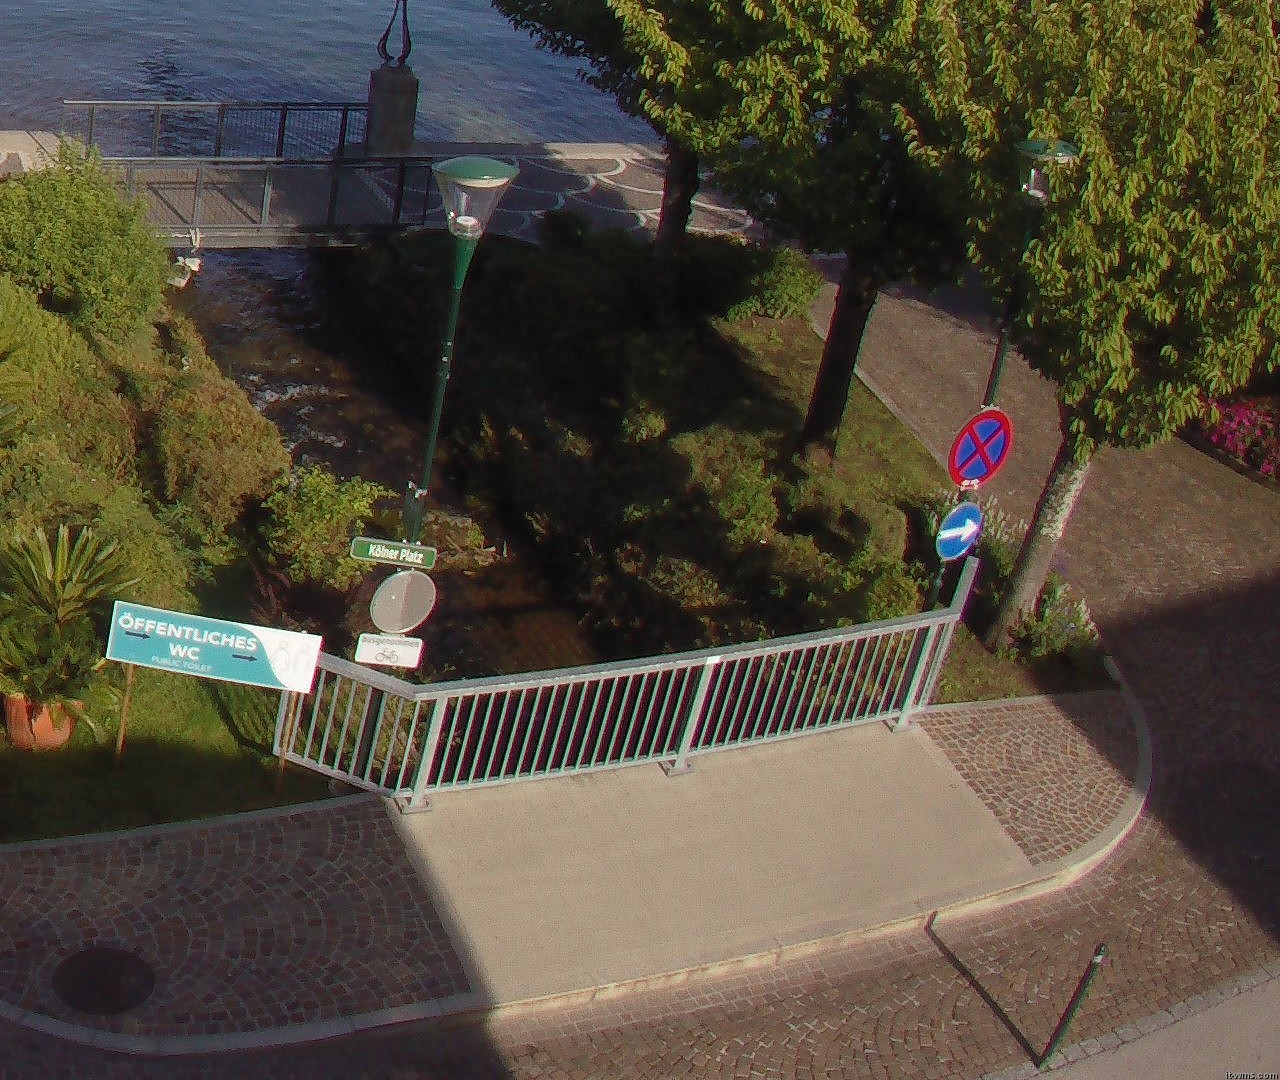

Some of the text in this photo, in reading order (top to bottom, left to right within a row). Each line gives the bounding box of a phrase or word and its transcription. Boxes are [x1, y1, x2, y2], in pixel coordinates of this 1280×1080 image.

[368, 543, 424, 563] Kölner Platz
[119, 612, 258, 651] ÖFFENTLICHES
[169, 642, 200, 660] WC
